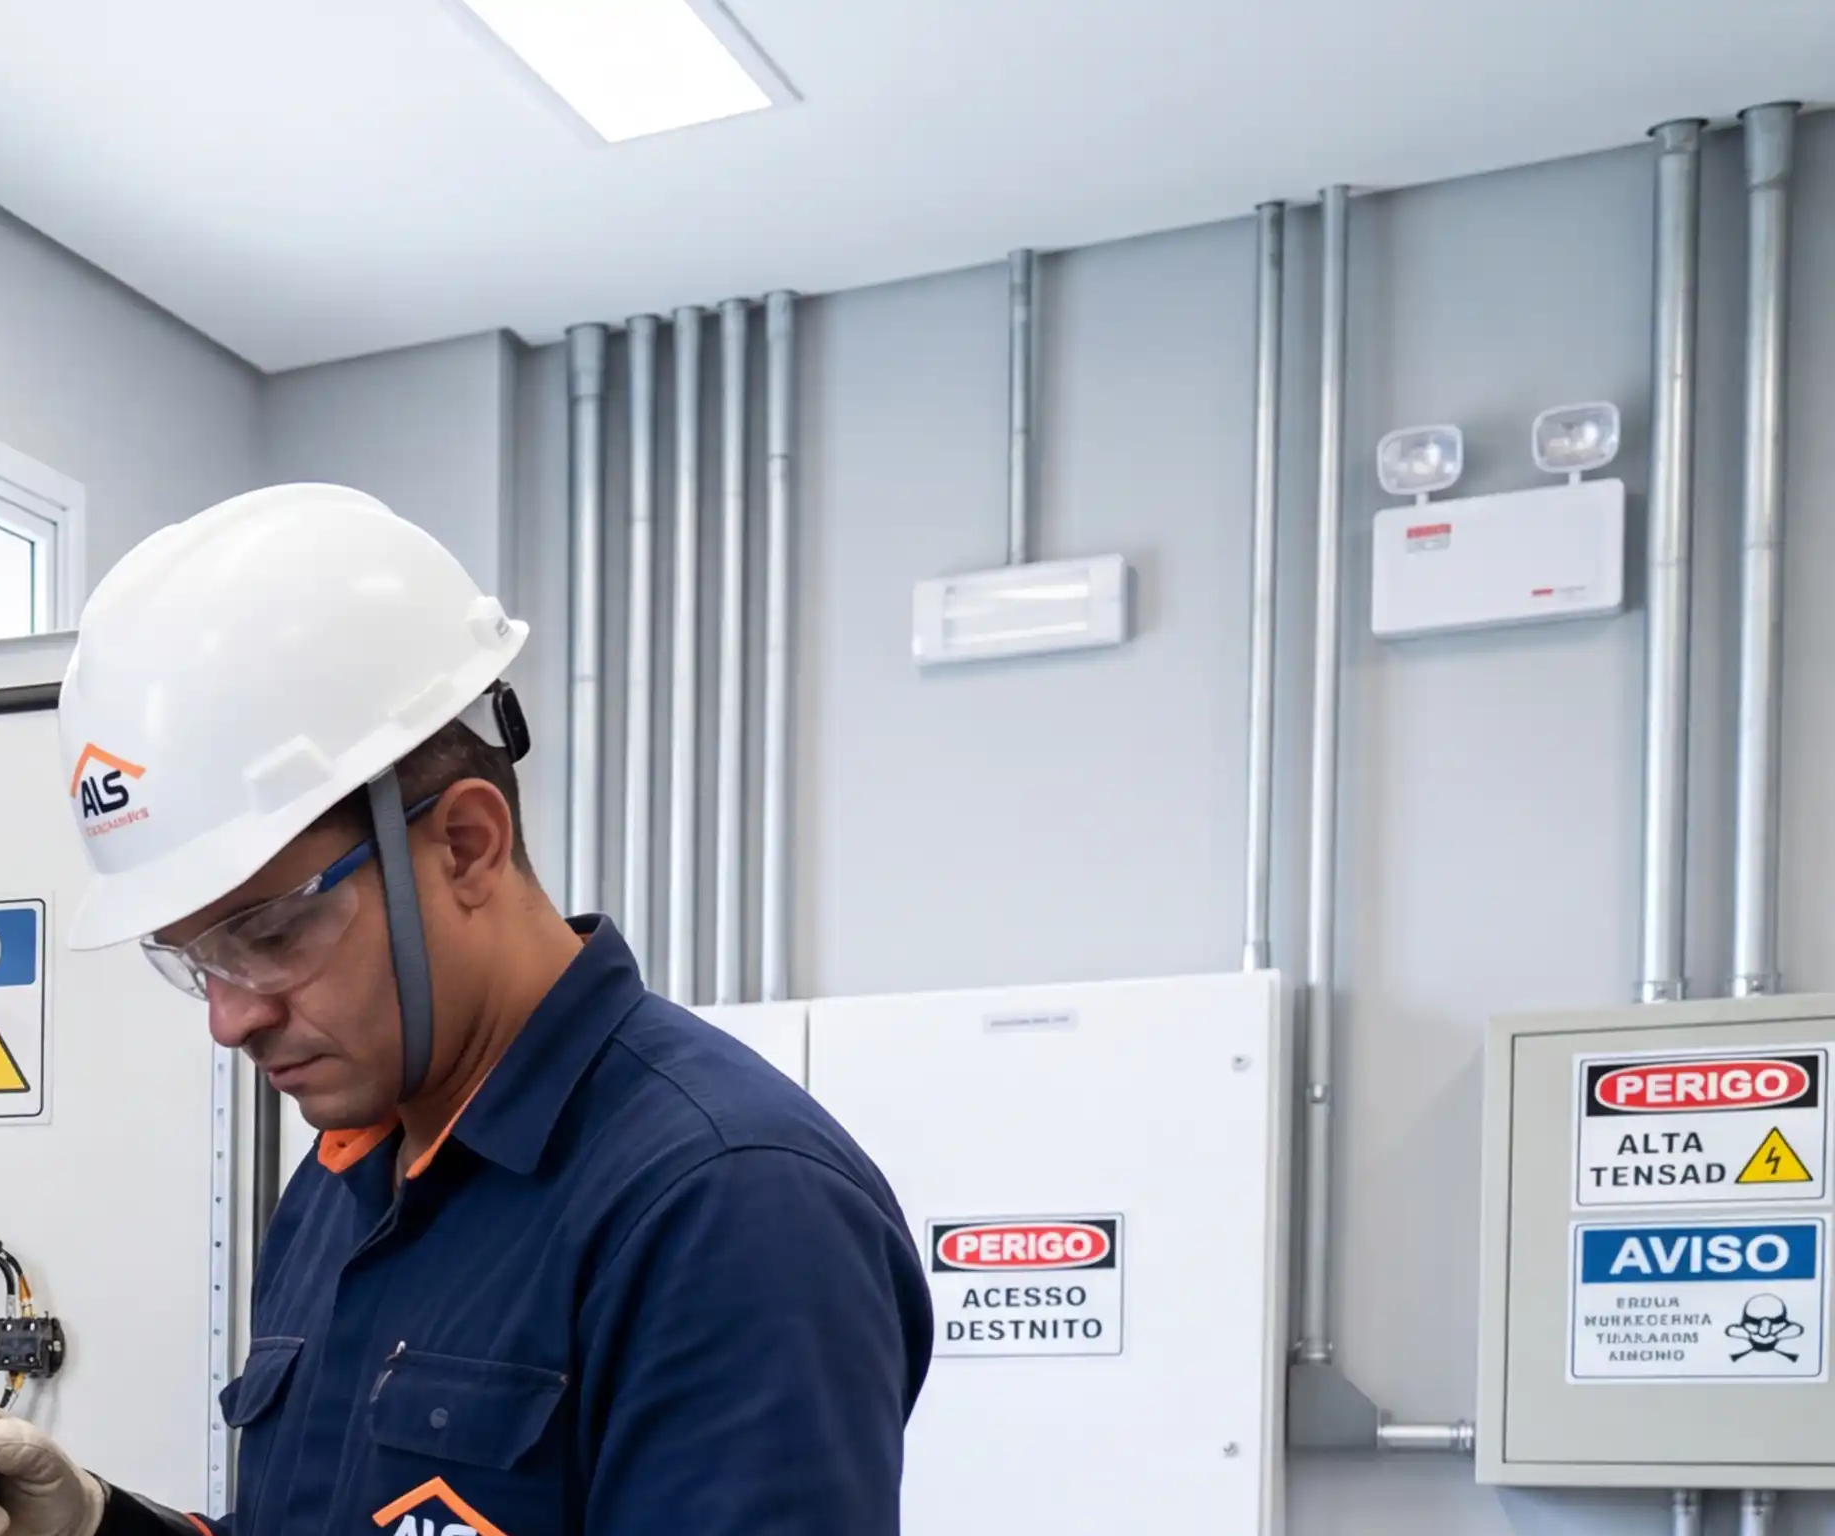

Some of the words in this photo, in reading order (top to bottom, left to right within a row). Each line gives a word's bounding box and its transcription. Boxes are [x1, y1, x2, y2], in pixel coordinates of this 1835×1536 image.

[81, 769, 129, 819] ALS
[1616, 1069, 1789, 1104] PERIGO
[1617, 1131, 1704, 1155] ALTA
[956, 1231, 1093, 1261] PERIGO
[1609, 1234, 1790, 1275] AVISO
[962, 1286, 1087, 1308] ACESSO
[947, 1318, 1103, 1341] DESTNITO
